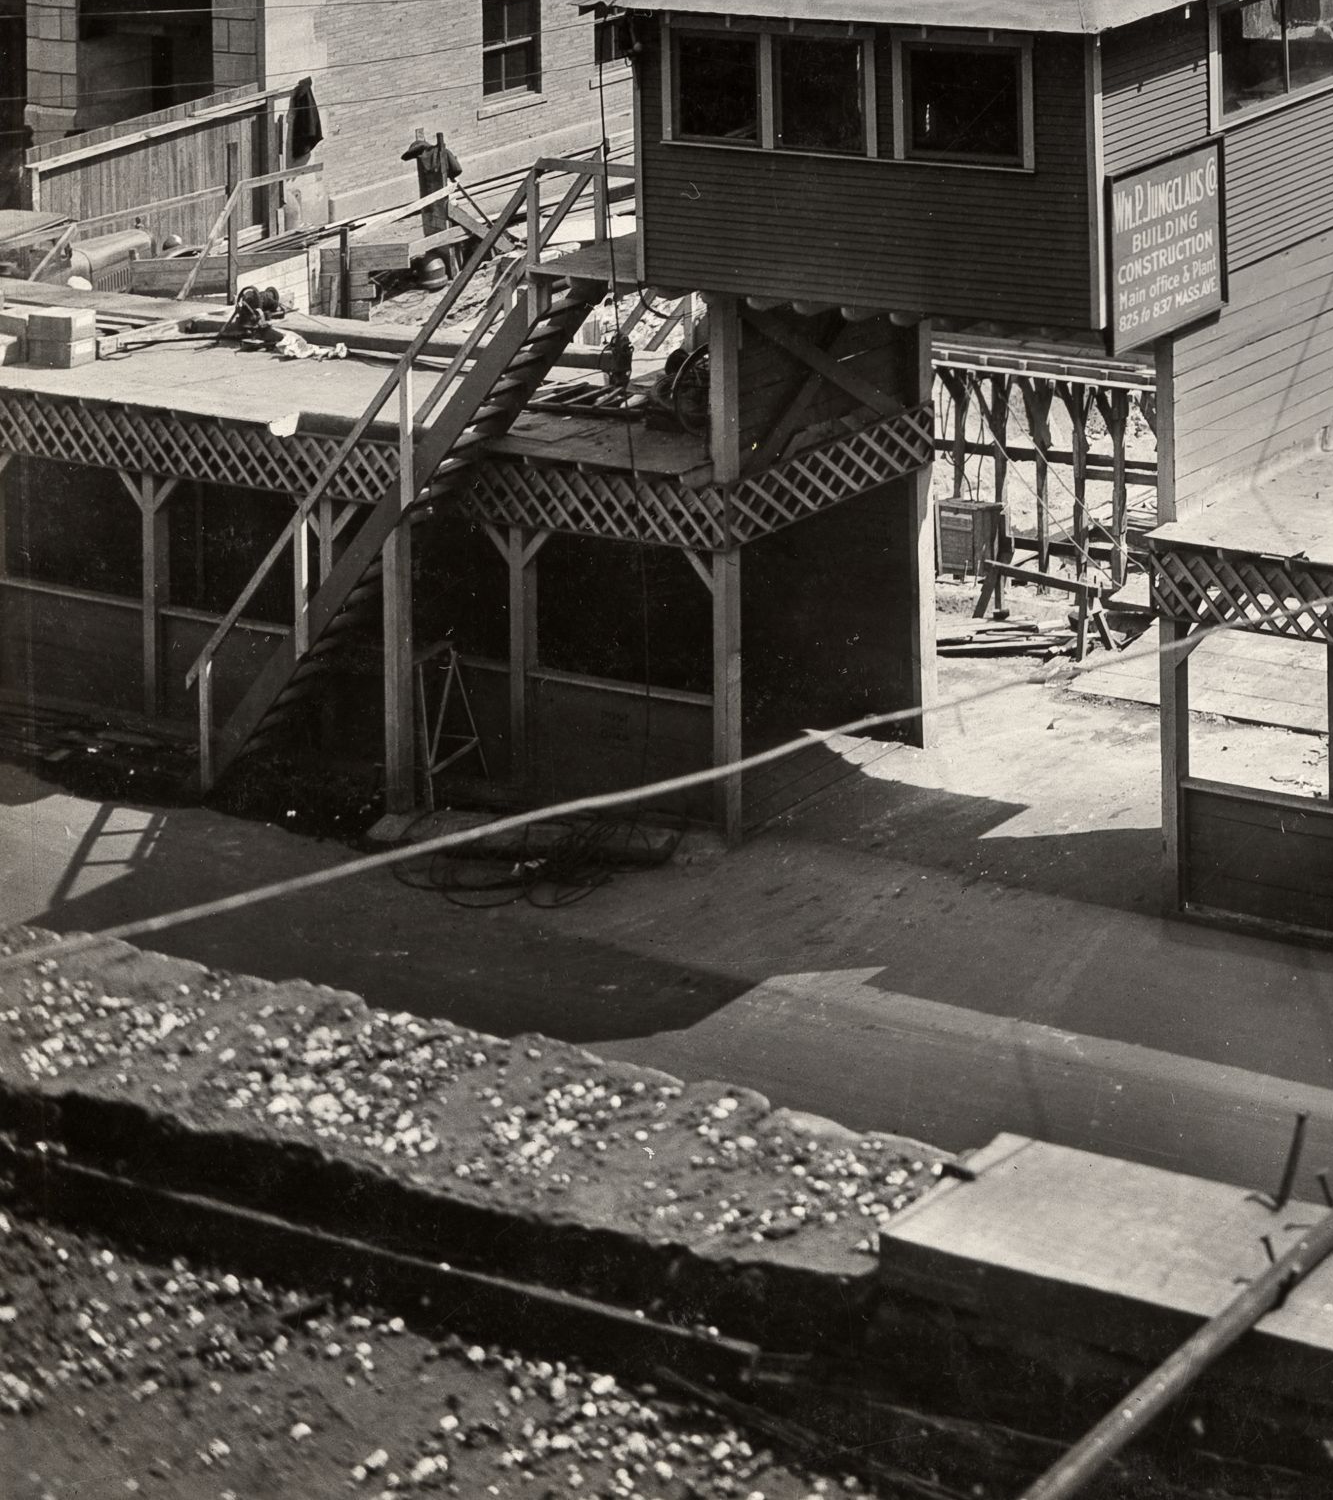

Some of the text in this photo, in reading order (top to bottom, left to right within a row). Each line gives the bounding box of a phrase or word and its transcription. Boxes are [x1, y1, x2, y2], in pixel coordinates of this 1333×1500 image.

[1132, 209, 1198, 253] BUILDING
[1117, 228, 1214, 285] CONSTRUCTION
[1119, 253, 1218, 312] Main office & Plant
[1119, 310, 1140, 333] 825
[1141, 306, 1152, 324] to
[1152, 298, 1173, 318] 837
